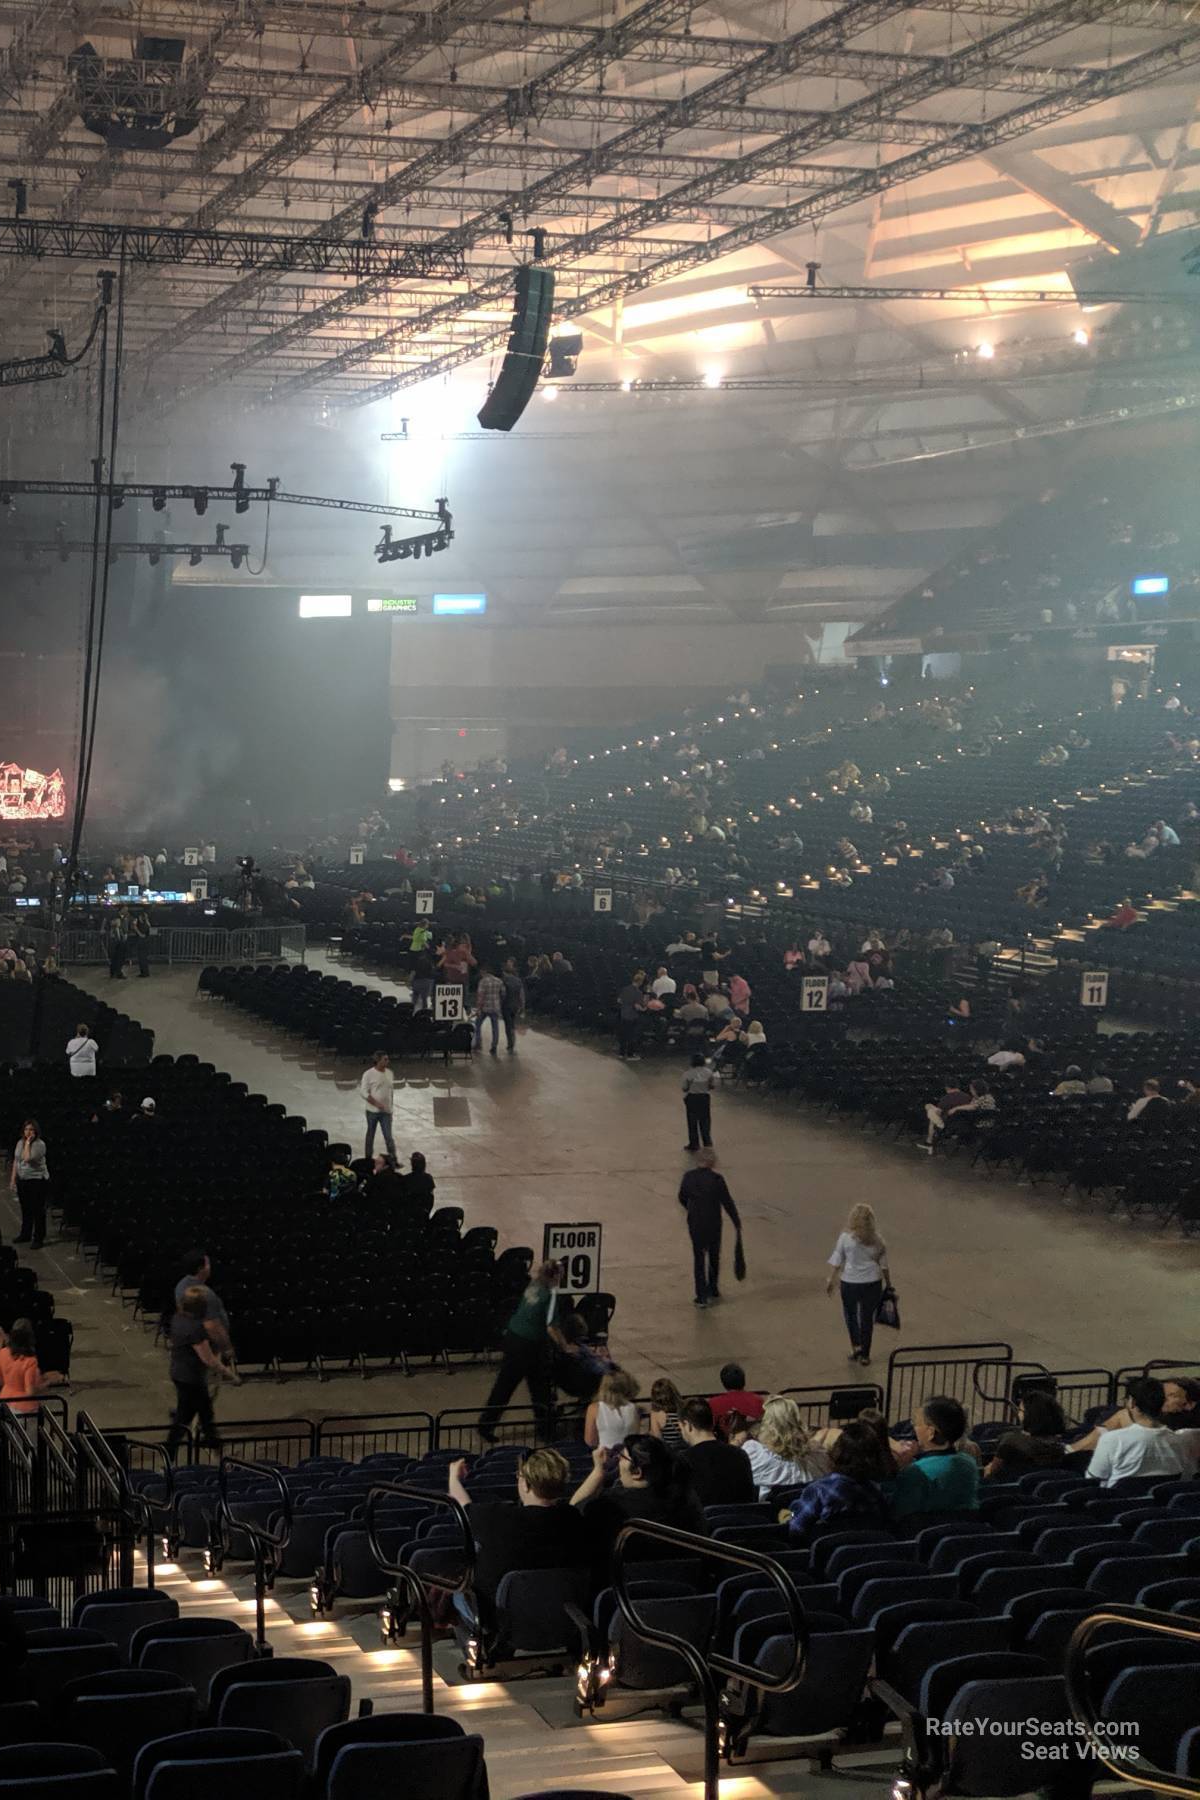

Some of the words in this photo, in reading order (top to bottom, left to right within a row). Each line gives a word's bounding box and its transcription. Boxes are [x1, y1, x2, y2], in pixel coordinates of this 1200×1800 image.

[422, 900, 427, 912] 7
[600, 897, 607, 909] 6
[438, 987, 461, 996] FLOOR
[807, 991, 823, 1008] 12
[1088, 986, 1102, 1003] 11
[440, 1000, 458, 1017] 13
[552, 1231, 596, 1248] FLOOR
[559, 1254, 591, 1288] 19
